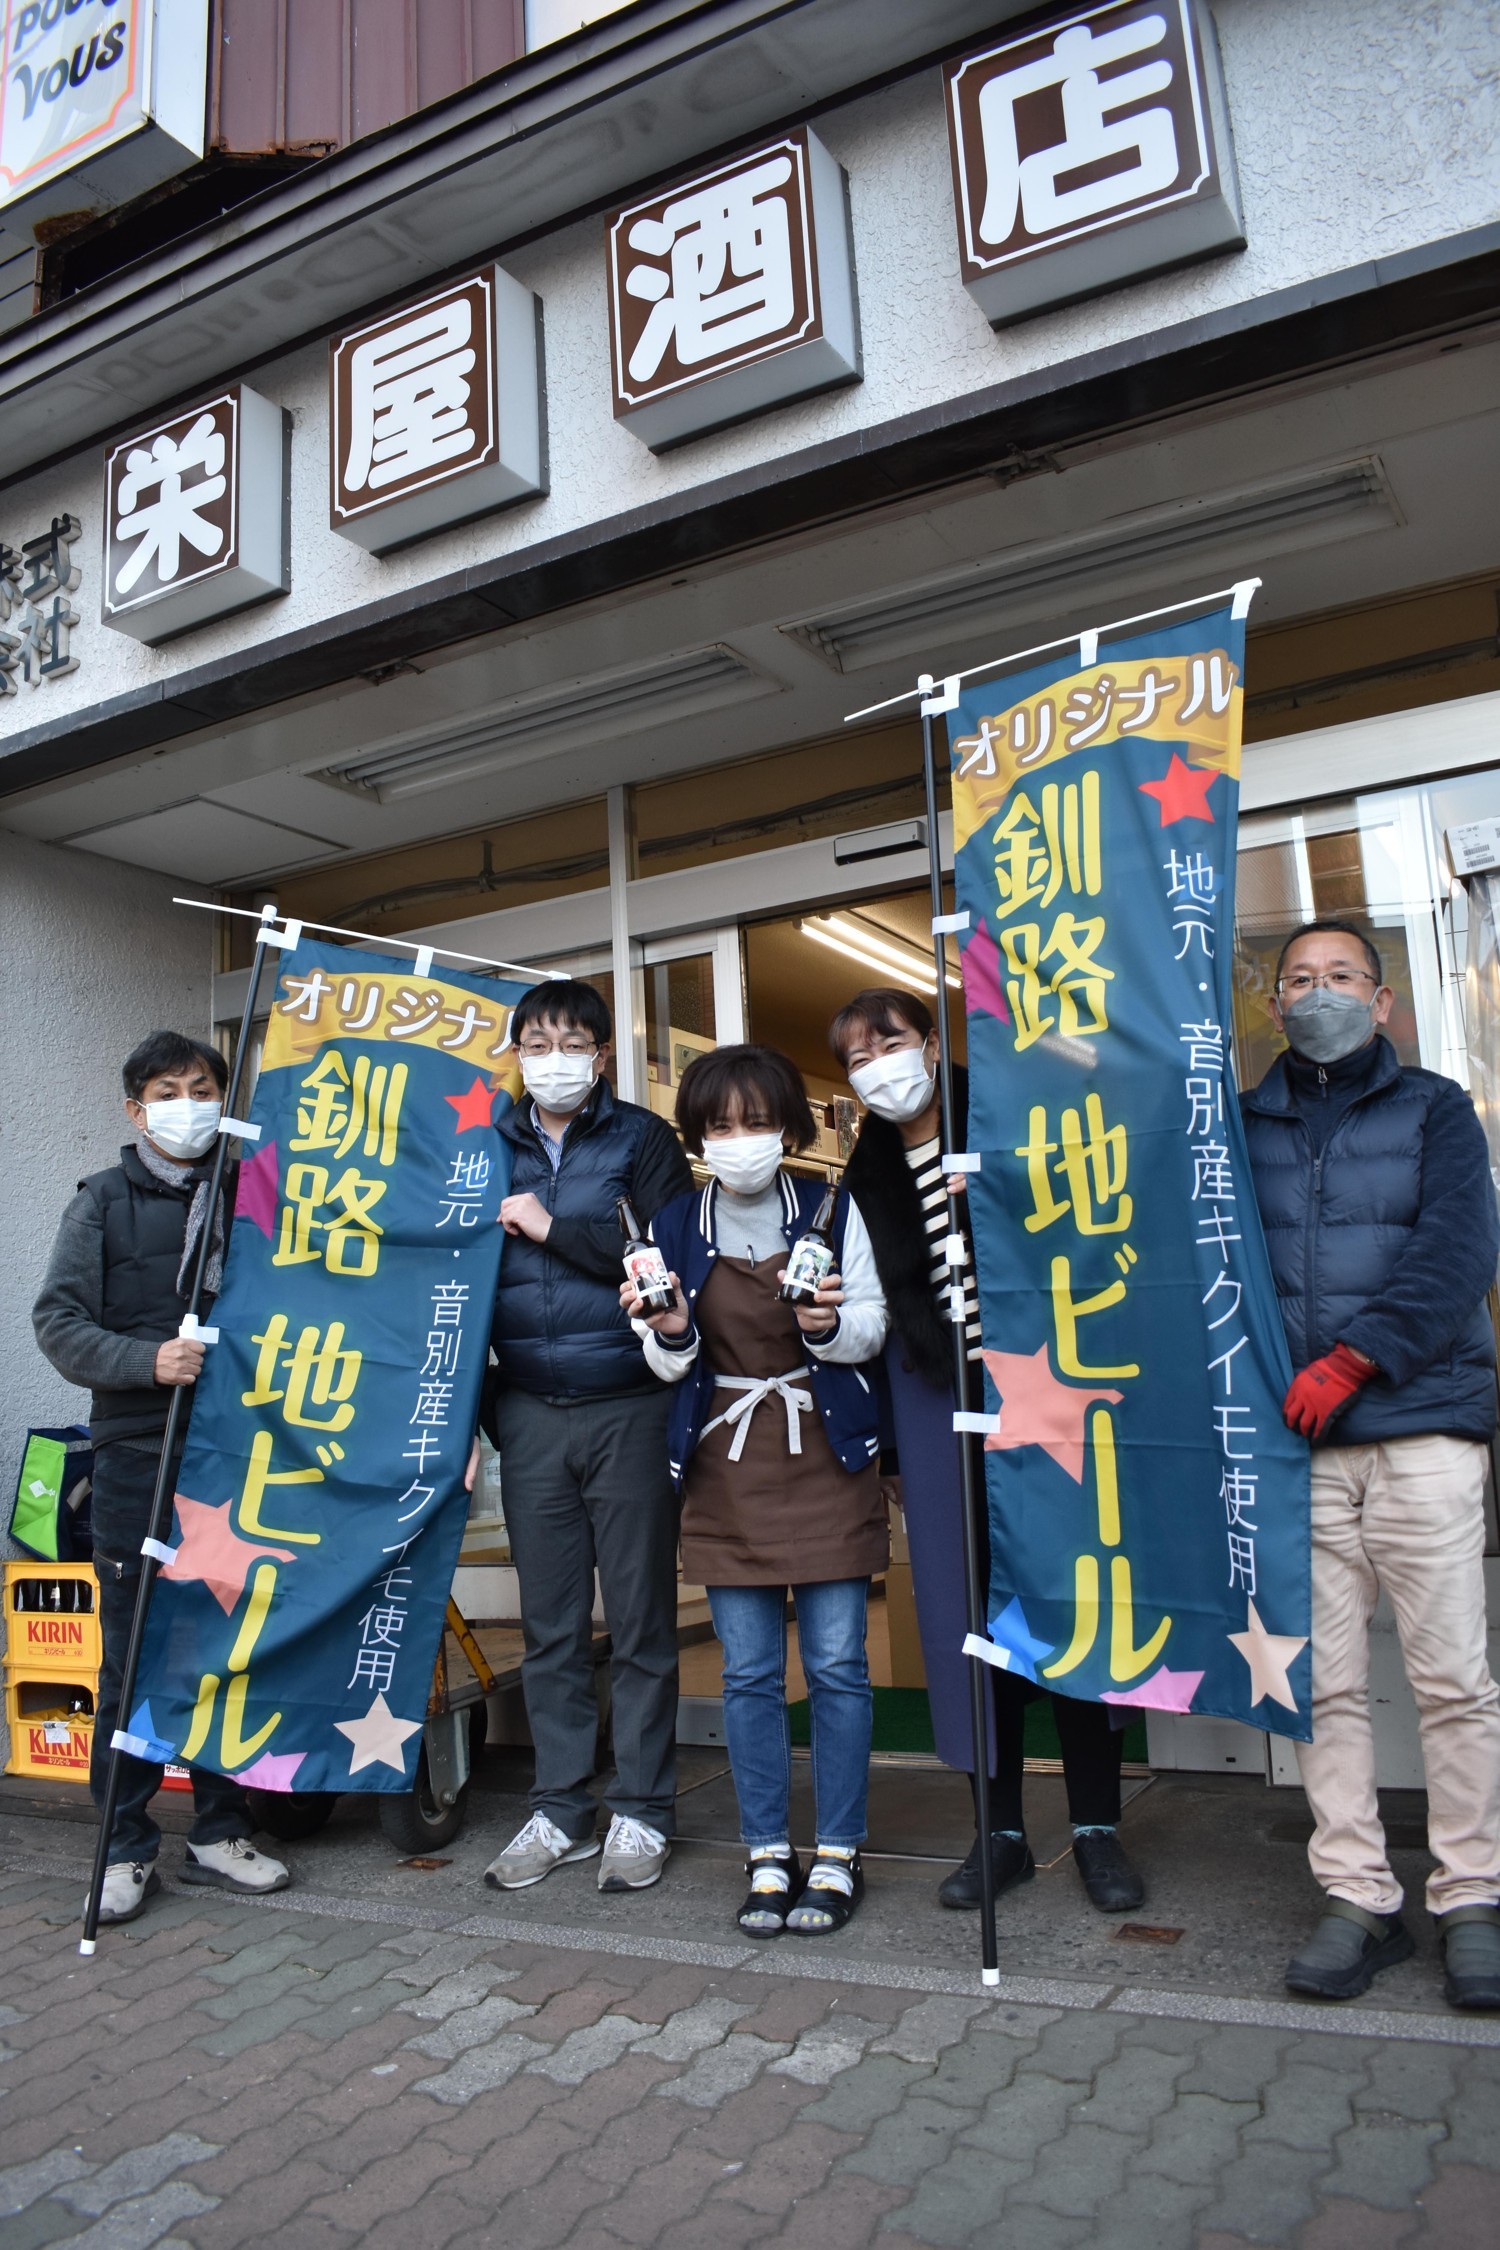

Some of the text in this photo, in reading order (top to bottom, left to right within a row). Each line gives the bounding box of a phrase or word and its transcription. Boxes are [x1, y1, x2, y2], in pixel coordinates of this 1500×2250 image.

[13, 21, 127, 121] VOUS
[957, 655, 1235, 776] オリジナル
[27, 1620, 83, 1644] KIRIN
